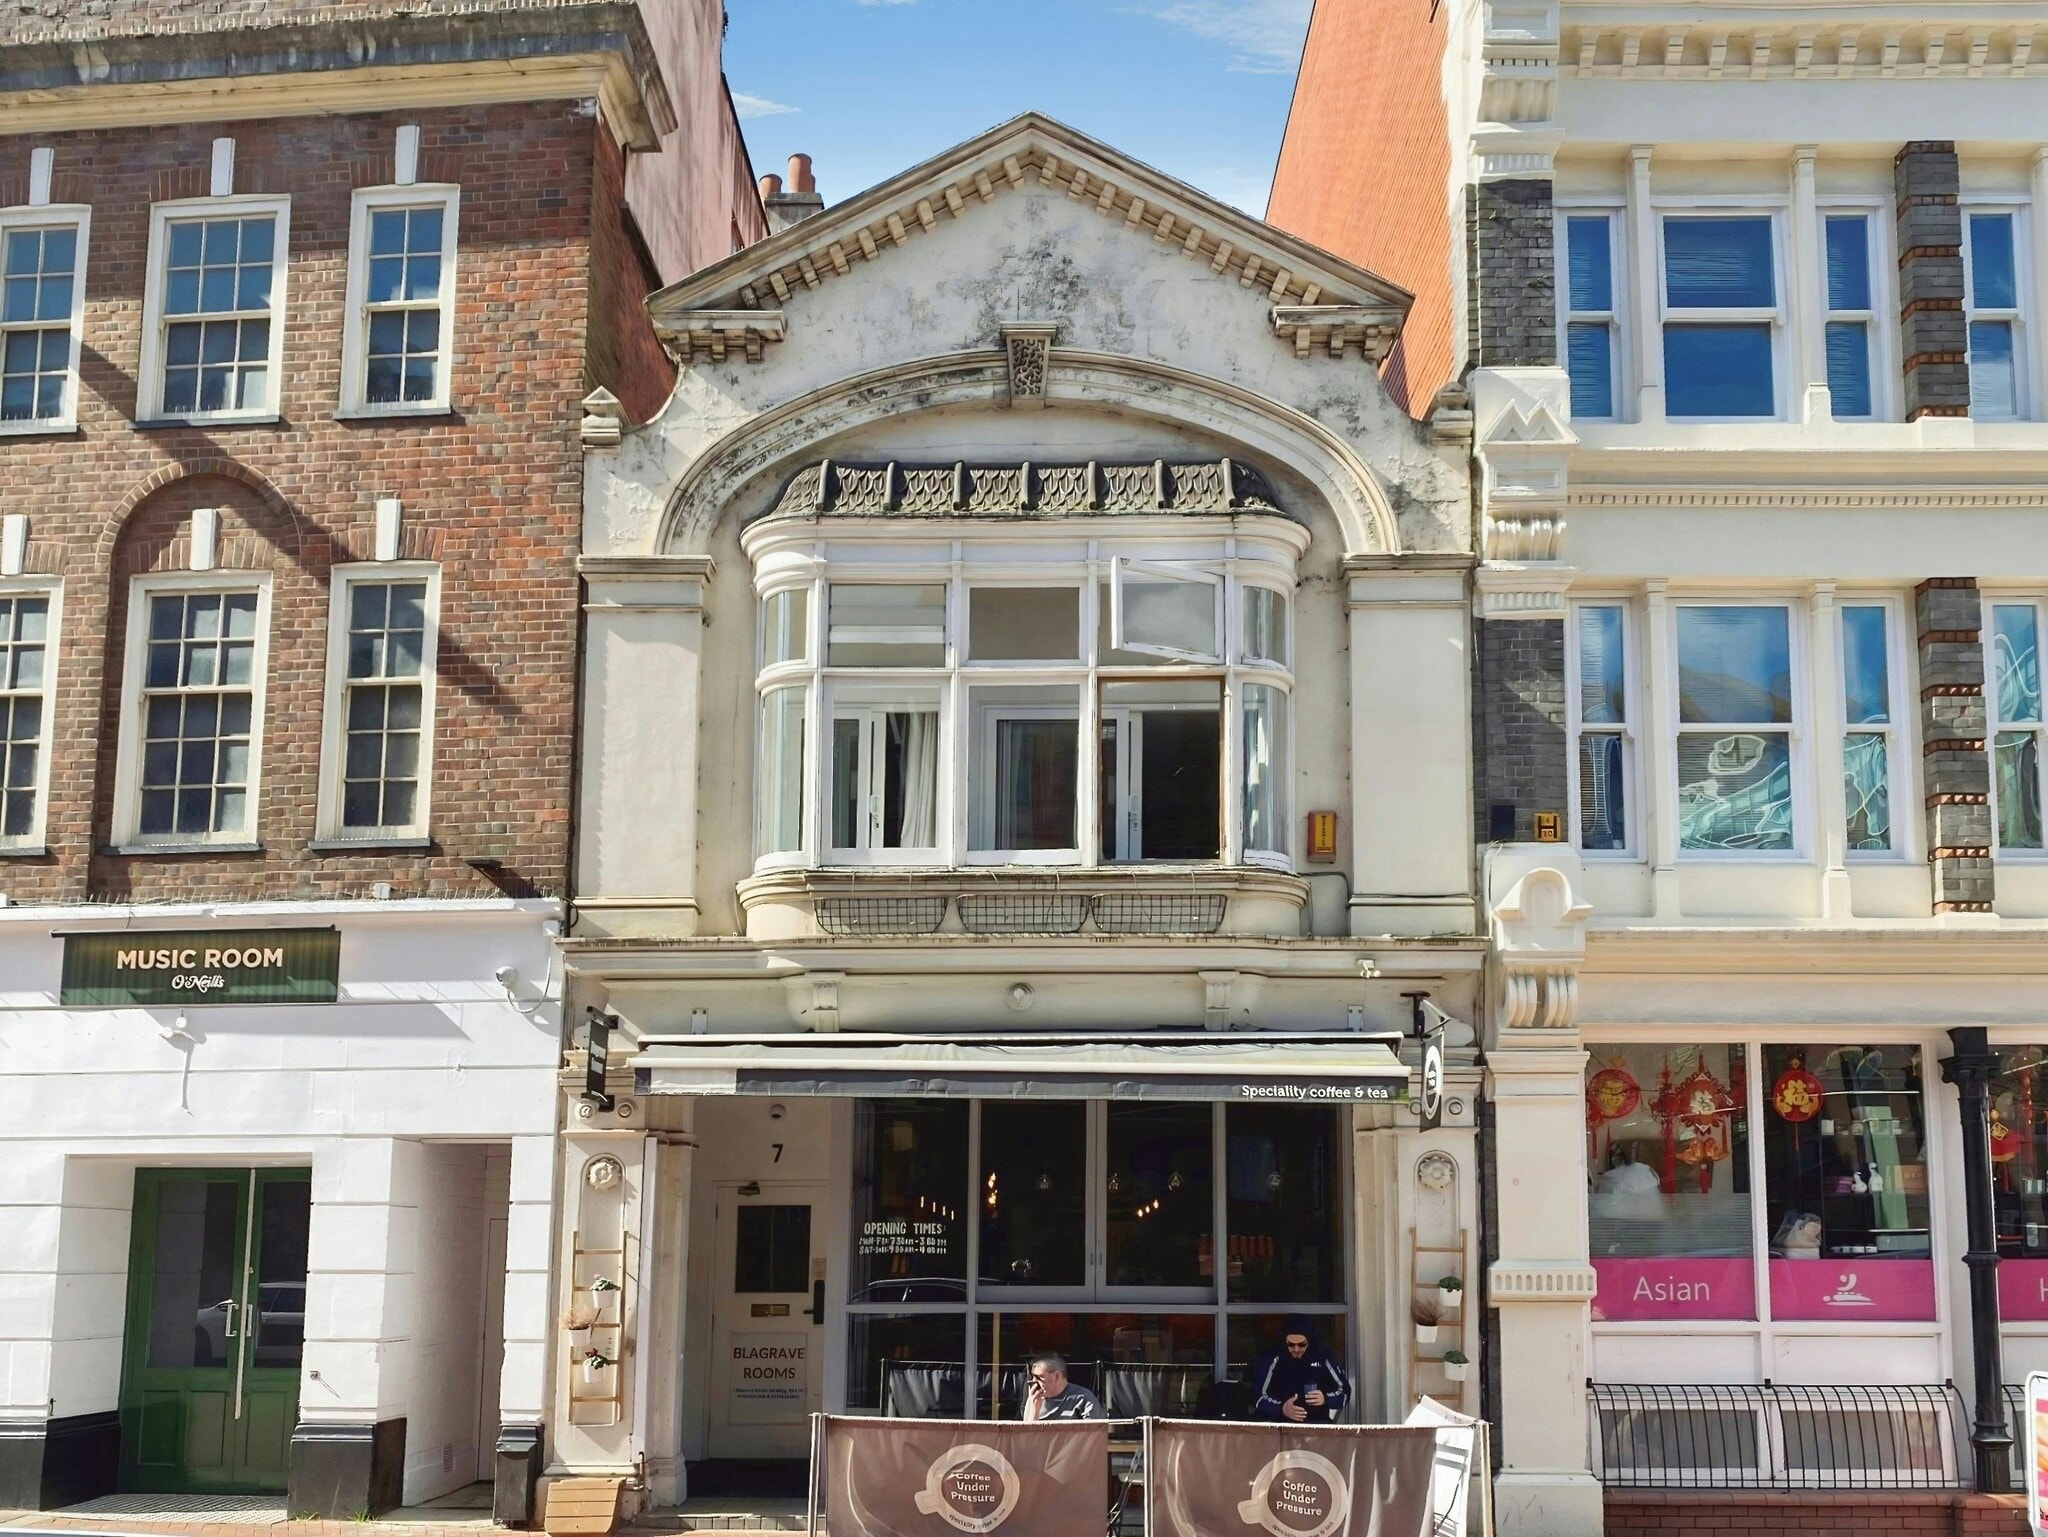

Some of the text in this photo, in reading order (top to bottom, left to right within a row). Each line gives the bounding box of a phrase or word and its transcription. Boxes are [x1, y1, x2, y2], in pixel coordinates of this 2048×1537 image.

[116, 948, 284, 970] MUSIC ROOM
[171, 974, 226, 994] O'Neill's
[1242, 1085, 1389, 1099] Speciality coffee & tea
[772, 1143, 784, 1163] 7
[863, 1221, 907, 1235] OPENING
[1633, 1275, 1710, 1301] Asian
[733, 1347, 805, 1359] BLAGRAVE
[743, 1367, 796, 1379] ROOMS
[956, 1472, 991, 1481] Coffee
[956, 1480, 990, 1492] Under
[1282, 1479, 1318, 1494] Coffee
[951, 1491, 996, 1503] Pressure
[1283, 1489, 1317, 1504] Under
[1276, 1500, 1323, 1516] Pressure
